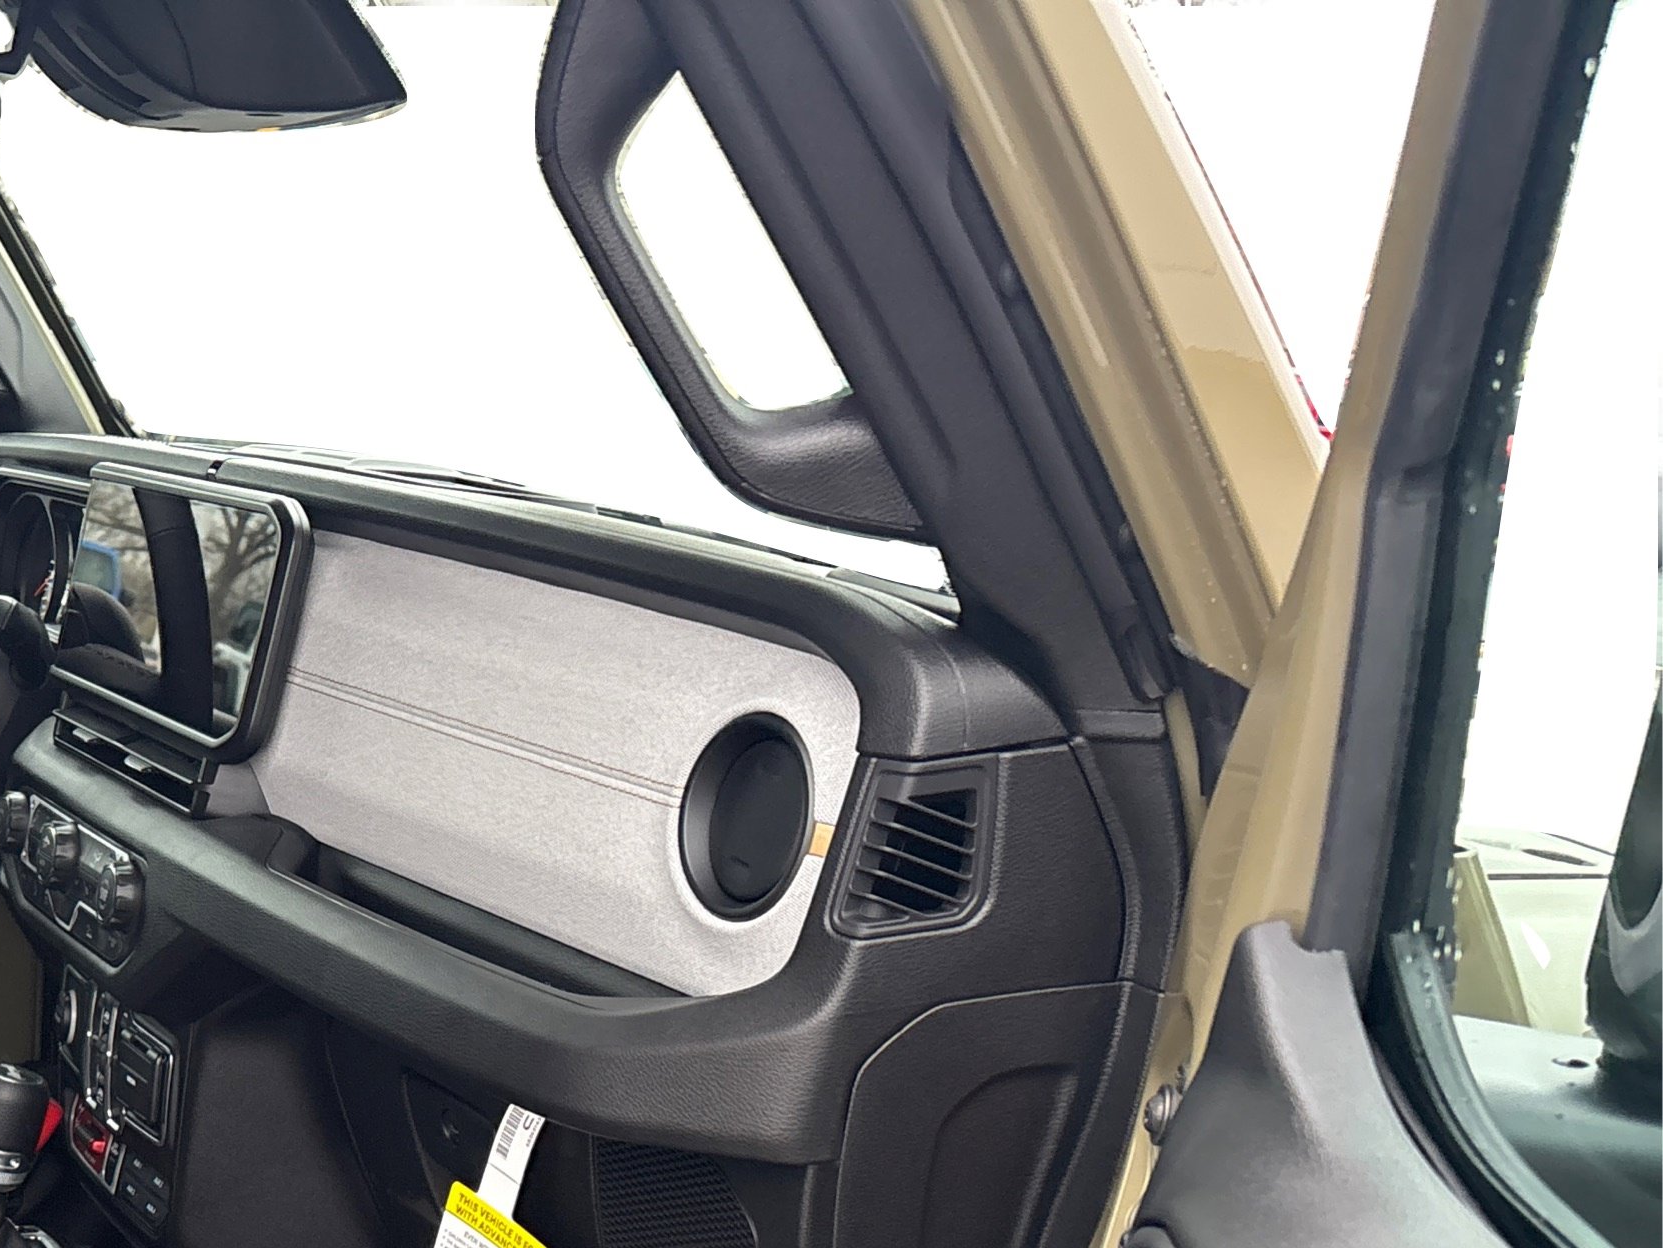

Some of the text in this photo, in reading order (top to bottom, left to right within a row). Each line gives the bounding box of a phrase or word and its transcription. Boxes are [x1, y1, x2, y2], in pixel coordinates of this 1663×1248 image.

[456, 1204, 478, 1225] WITH
[459, 1193, 478, 1212] THIS
[481, 1207, 513, 1238] VEHICLE
[514, 1233, 522, 1245] IS
[464, 1231, 478, 1244] EVEN
